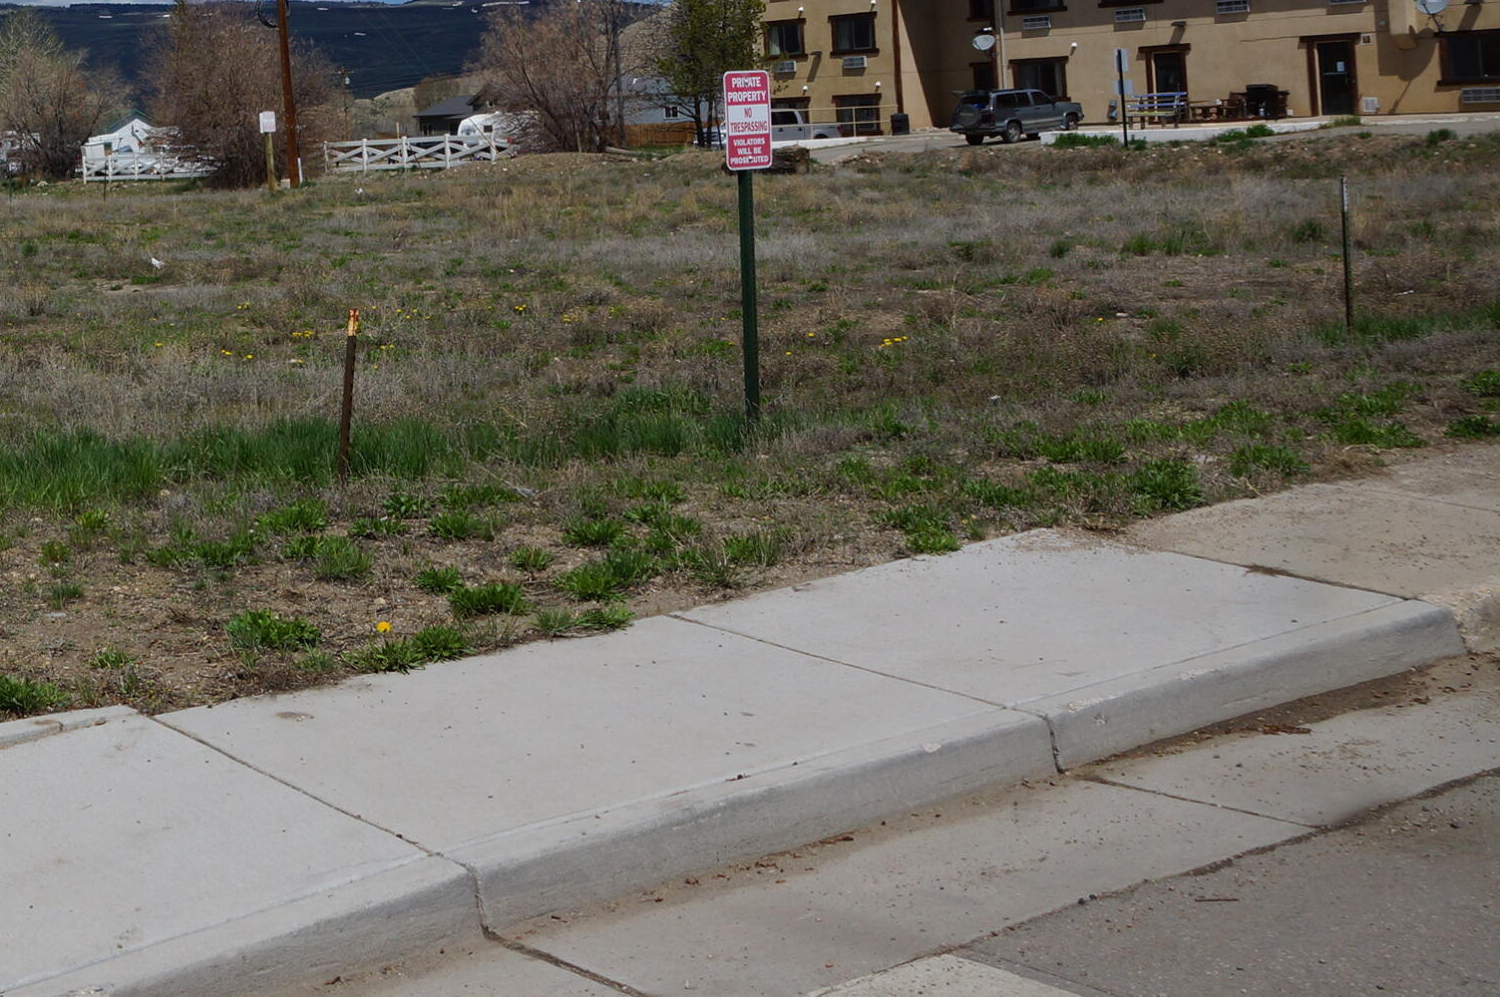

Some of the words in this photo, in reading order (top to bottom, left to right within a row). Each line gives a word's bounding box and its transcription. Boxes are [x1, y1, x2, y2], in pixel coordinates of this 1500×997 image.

[732, 77, 761, 88] PRIVATE
[728, 91, 766, 102] PROPERTY
[744, 108, 752, 118] NO
[730, 122, 768, 133] TRESPASSING
[733, 138, 765, 146] VIOLATORS
